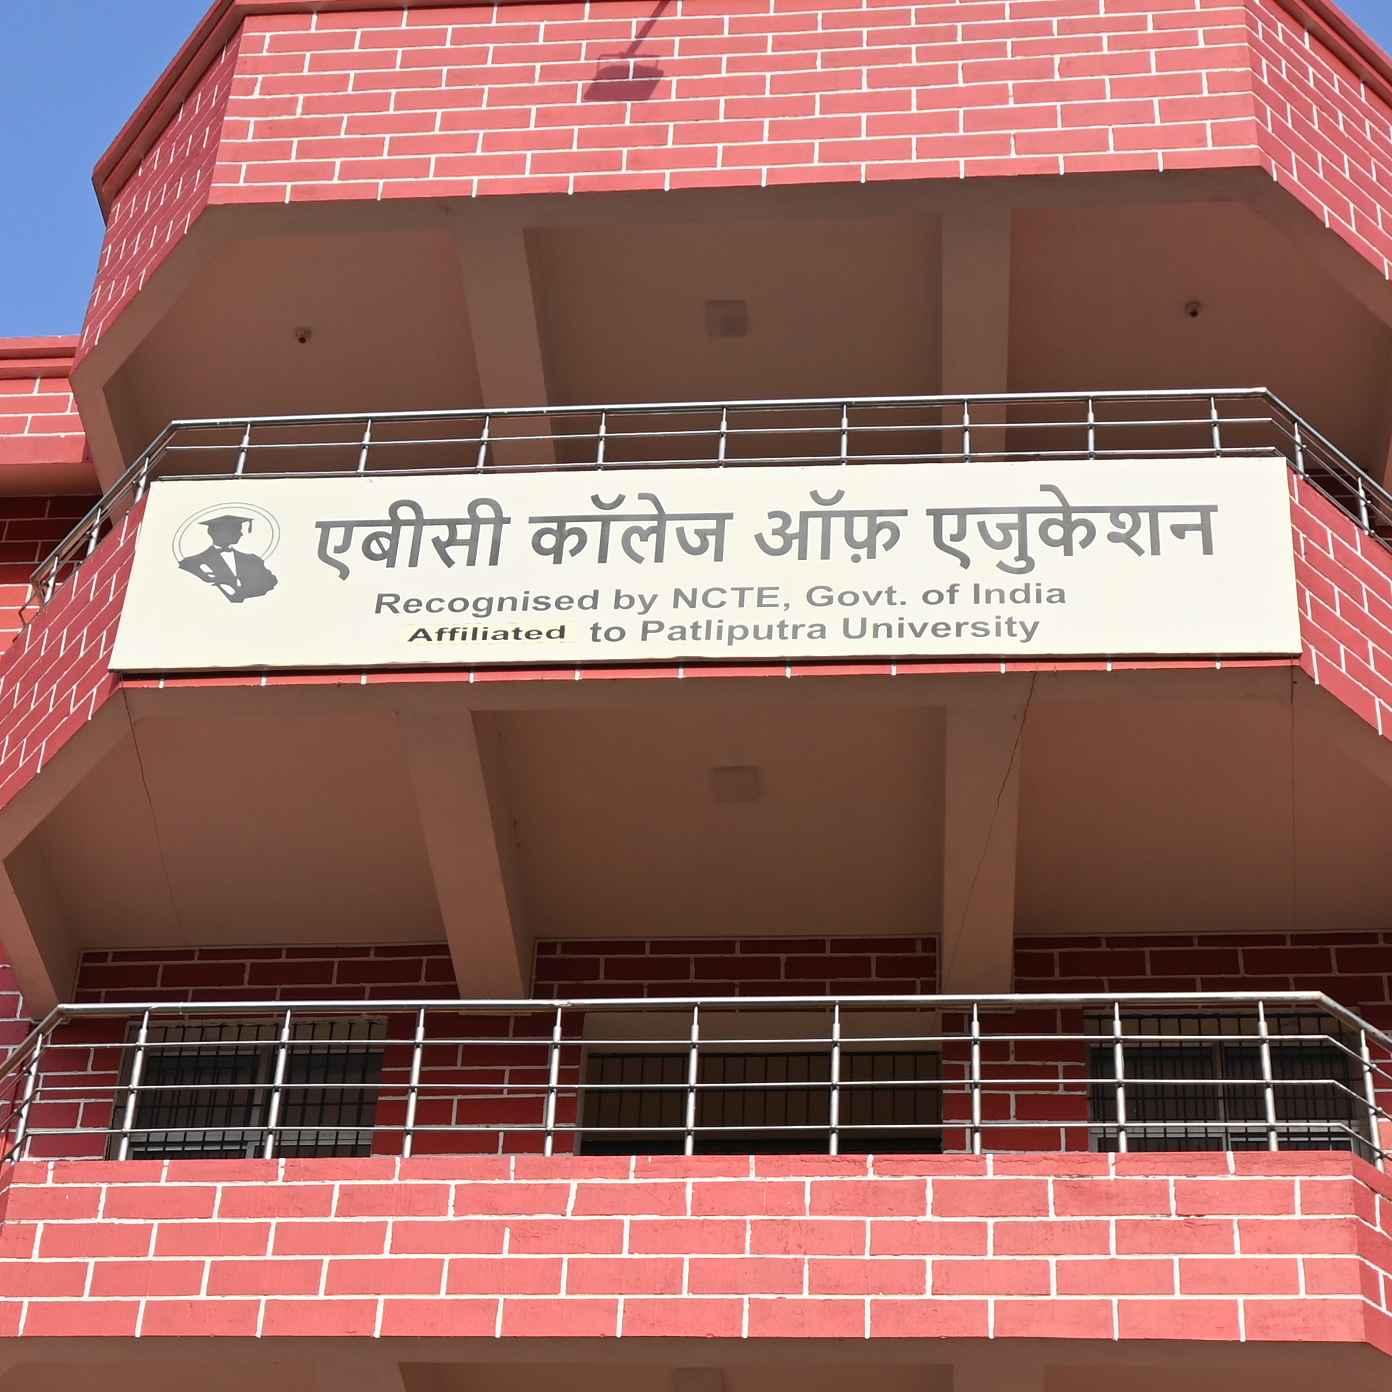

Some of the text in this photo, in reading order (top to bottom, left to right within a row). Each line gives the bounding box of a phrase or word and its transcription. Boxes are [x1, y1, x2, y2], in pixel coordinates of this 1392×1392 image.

[314, 484, 1219, 579] एबीसी कॉलेज ऑफ़ एजुकेशन
[374, 582, 1067, 619] Recognised by NCTE, Govt. of India
[407, 615, 1040, 646] Affiliated to Patliputra University
